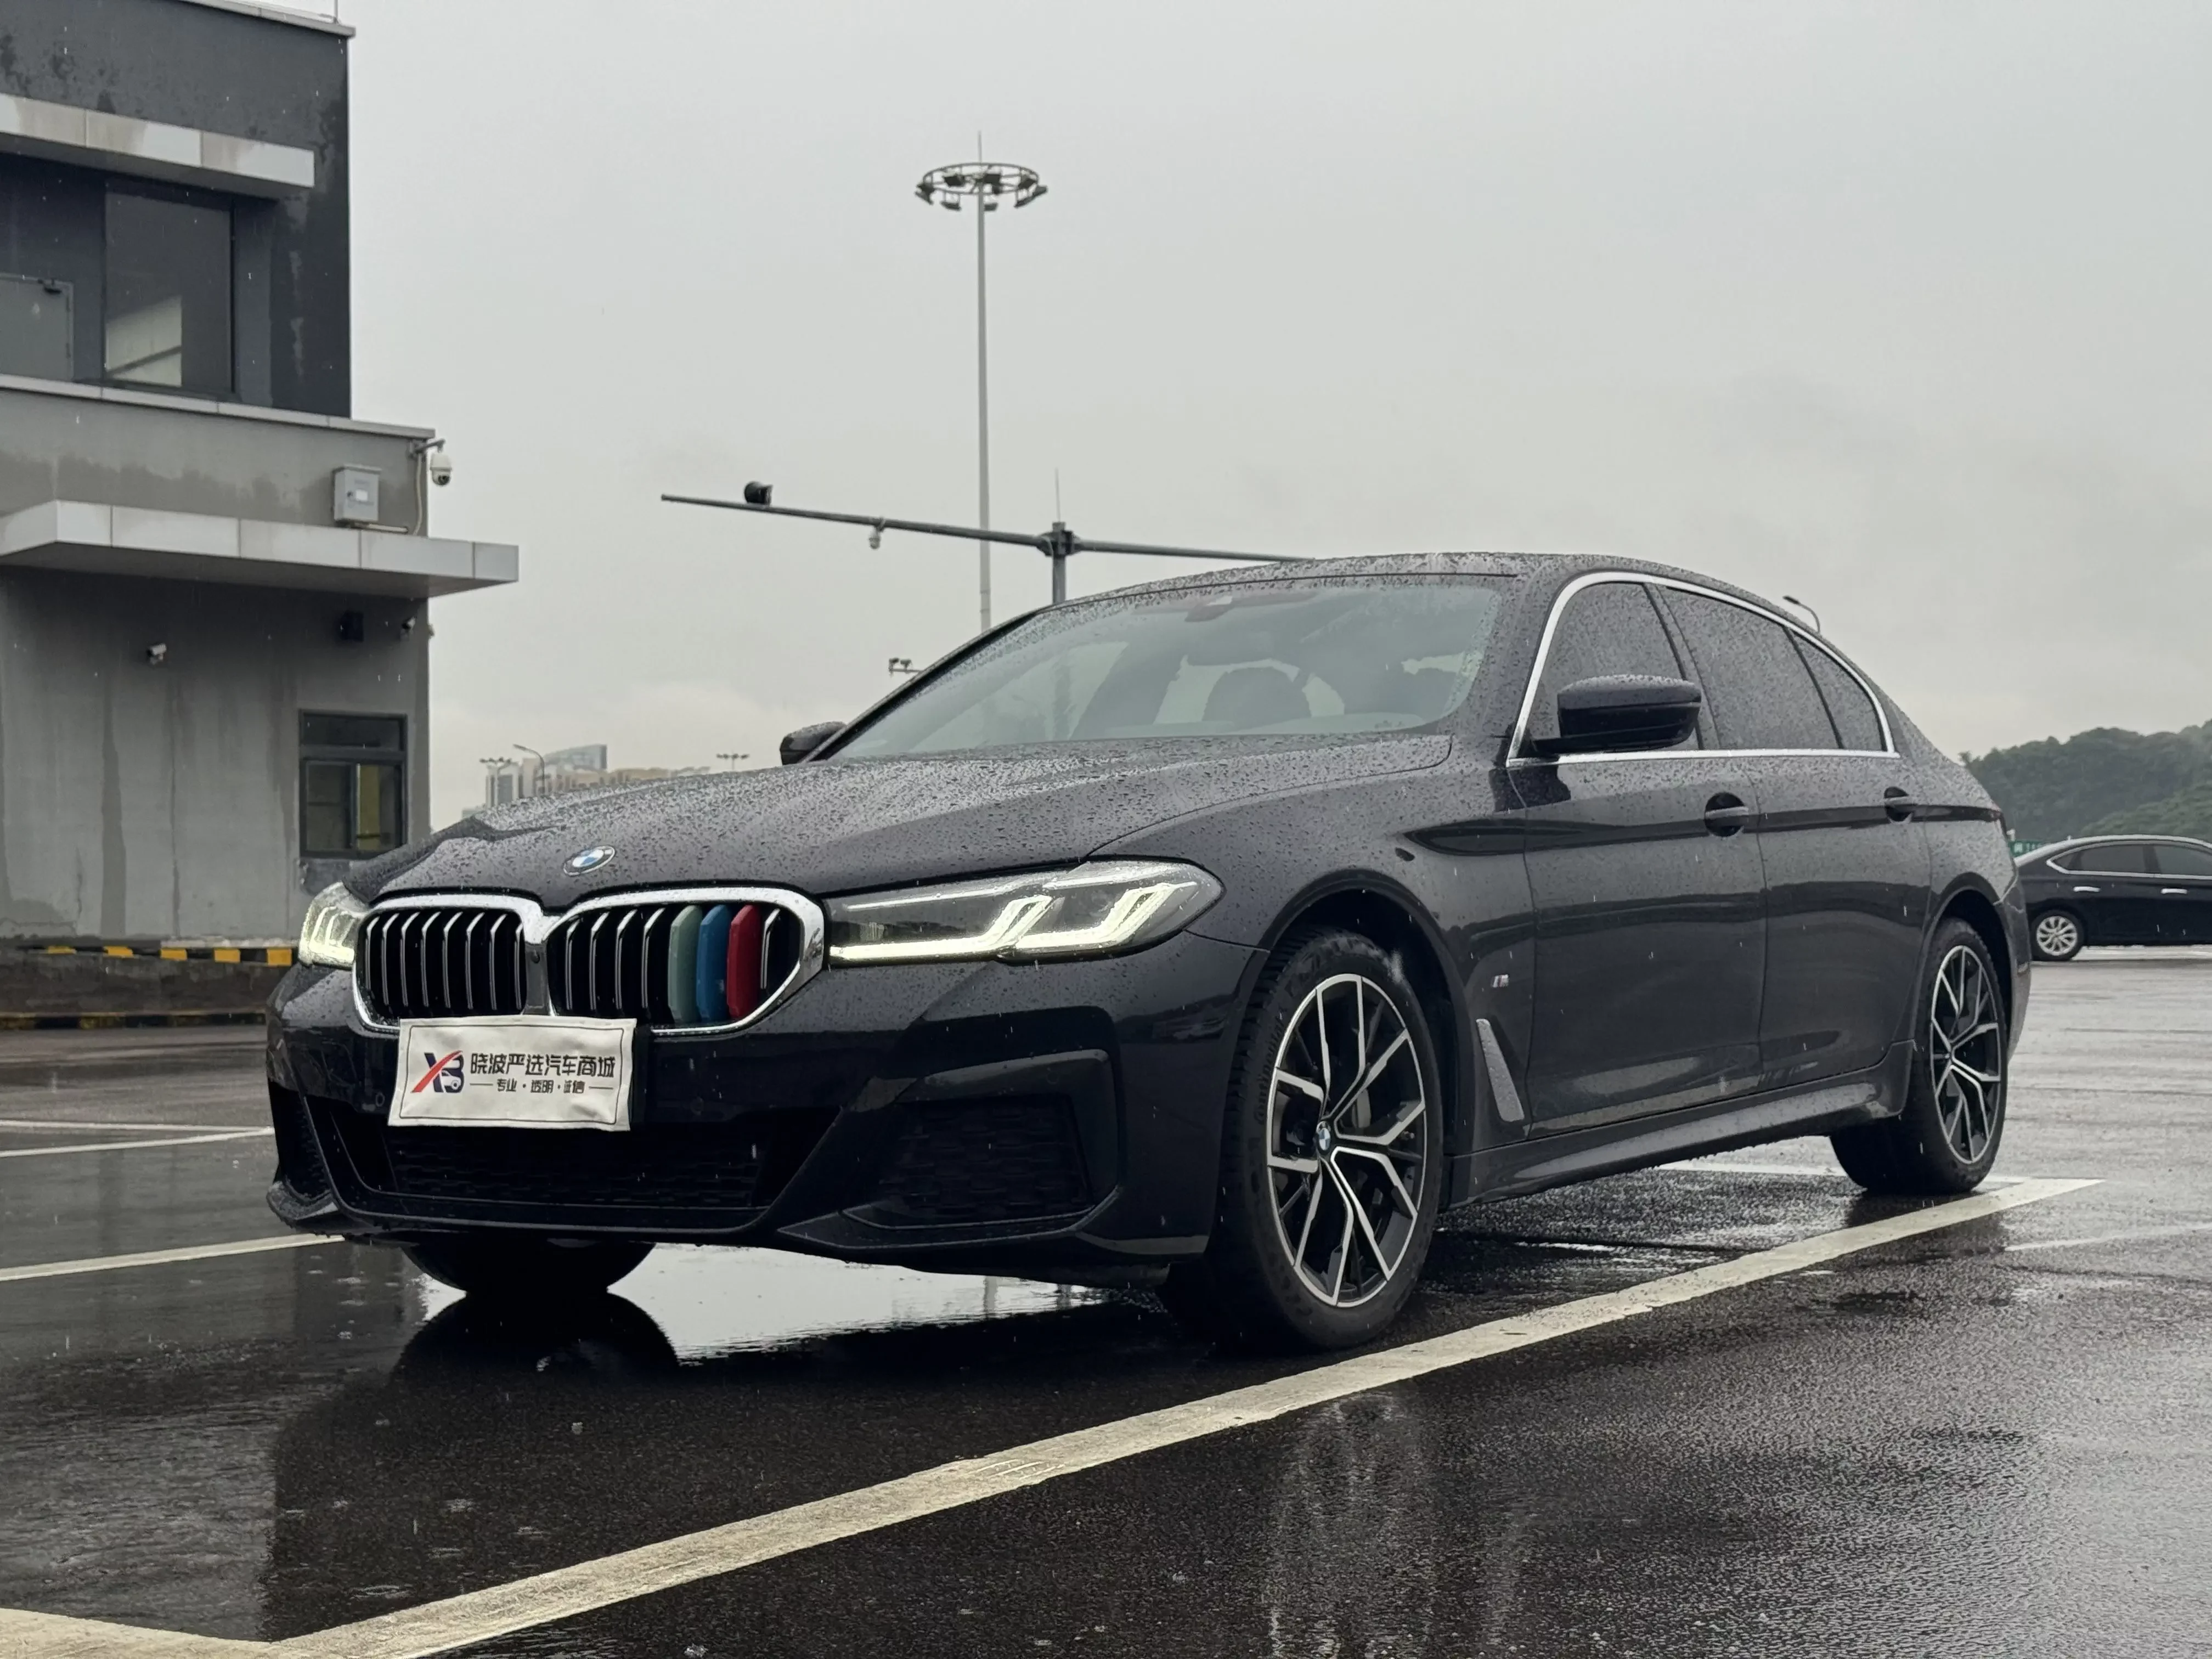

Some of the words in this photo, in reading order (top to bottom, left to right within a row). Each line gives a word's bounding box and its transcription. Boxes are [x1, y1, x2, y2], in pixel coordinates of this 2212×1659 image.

[470, 1053, 616, 1078] 晓波严选汽车商城
